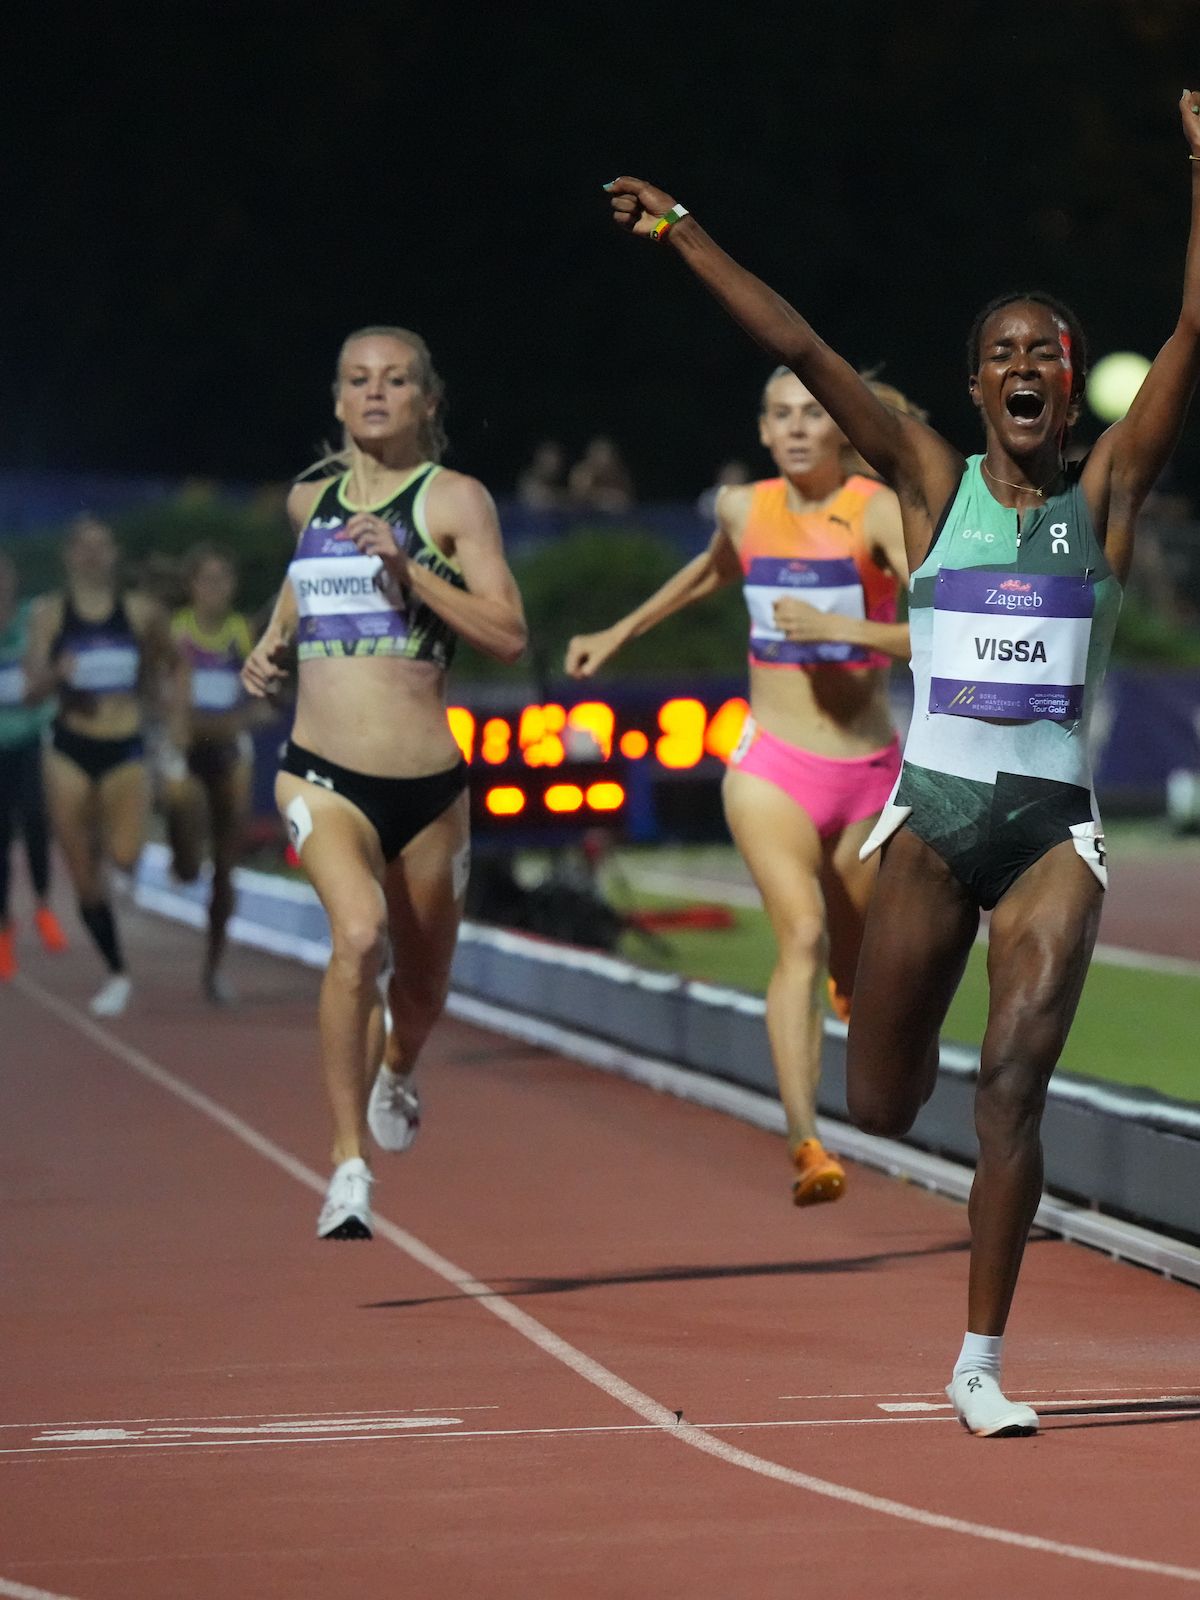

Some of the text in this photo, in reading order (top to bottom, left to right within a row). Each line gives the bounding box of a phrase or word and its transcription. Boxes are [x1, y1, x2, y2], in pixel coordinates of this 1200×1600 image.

[984, 588, 1043, 610] Zagreb
[974, 637, 1048, 663] VISSA
[1028, 697, 1070, 706] Continental
[1033, 705, 1066, 713] Tour Gold
